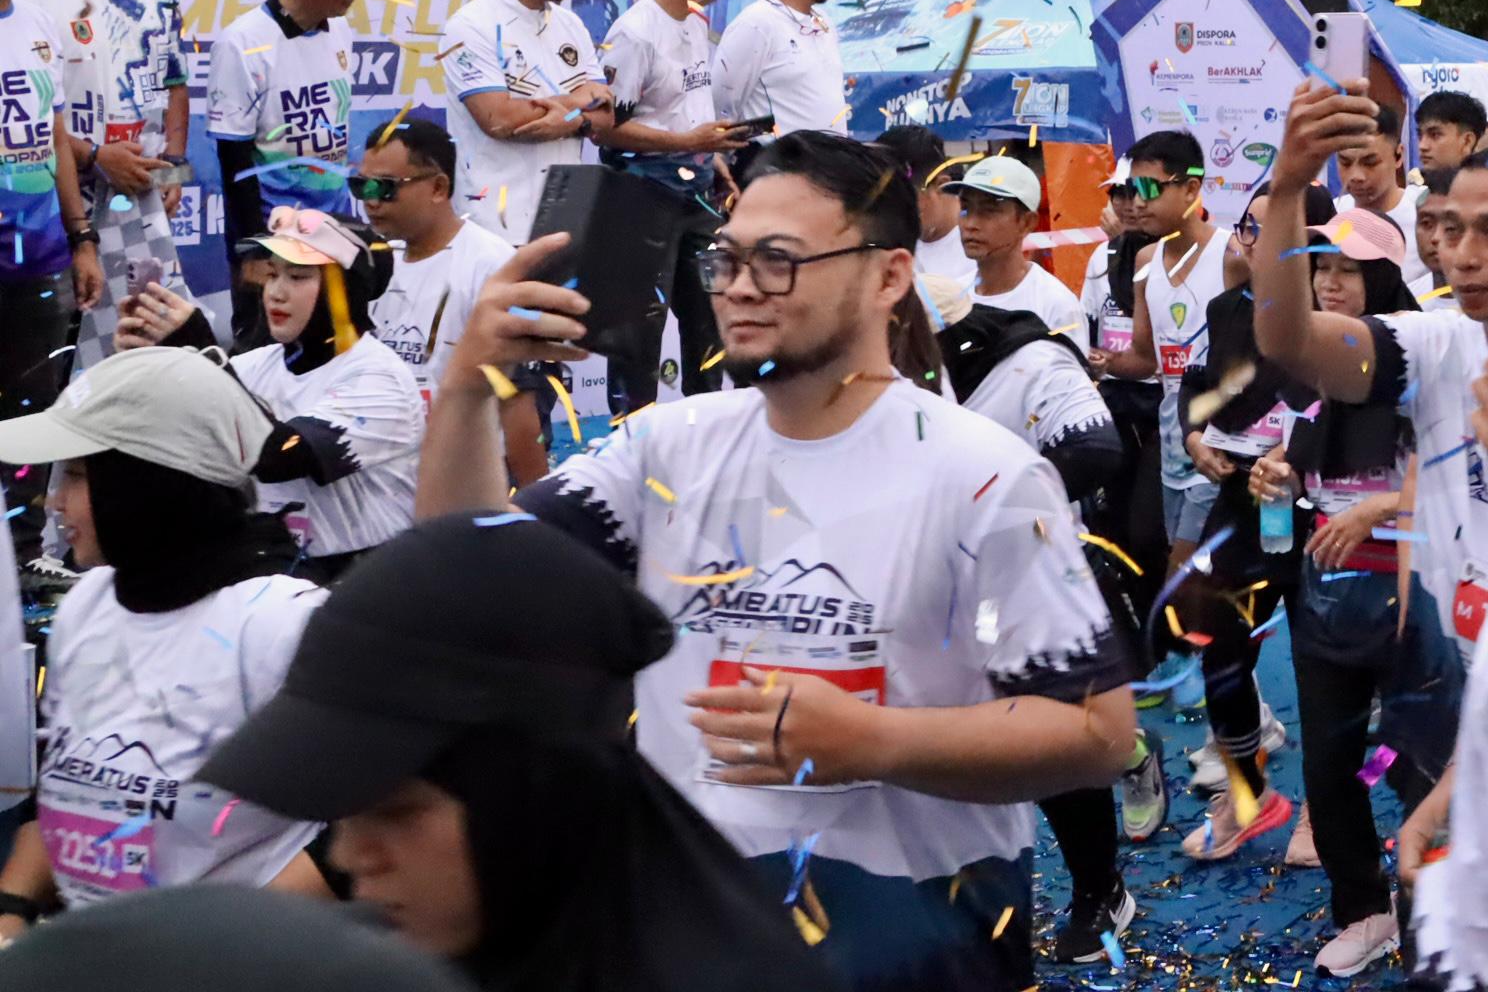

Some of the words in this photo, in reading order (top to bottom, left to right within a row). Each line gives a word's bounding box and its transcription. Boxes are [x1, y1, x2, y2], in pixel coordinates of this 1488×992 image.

[1197, 30, 1236, 39] DISPORA
[0, 70, 31, 96] E
[1208, 67, 1263, 76] BerAKHLAK
[281, 82, 330, 112] ME
[0, 122, 51, 149] US
[54, 756, 150, 795] MERATUS
